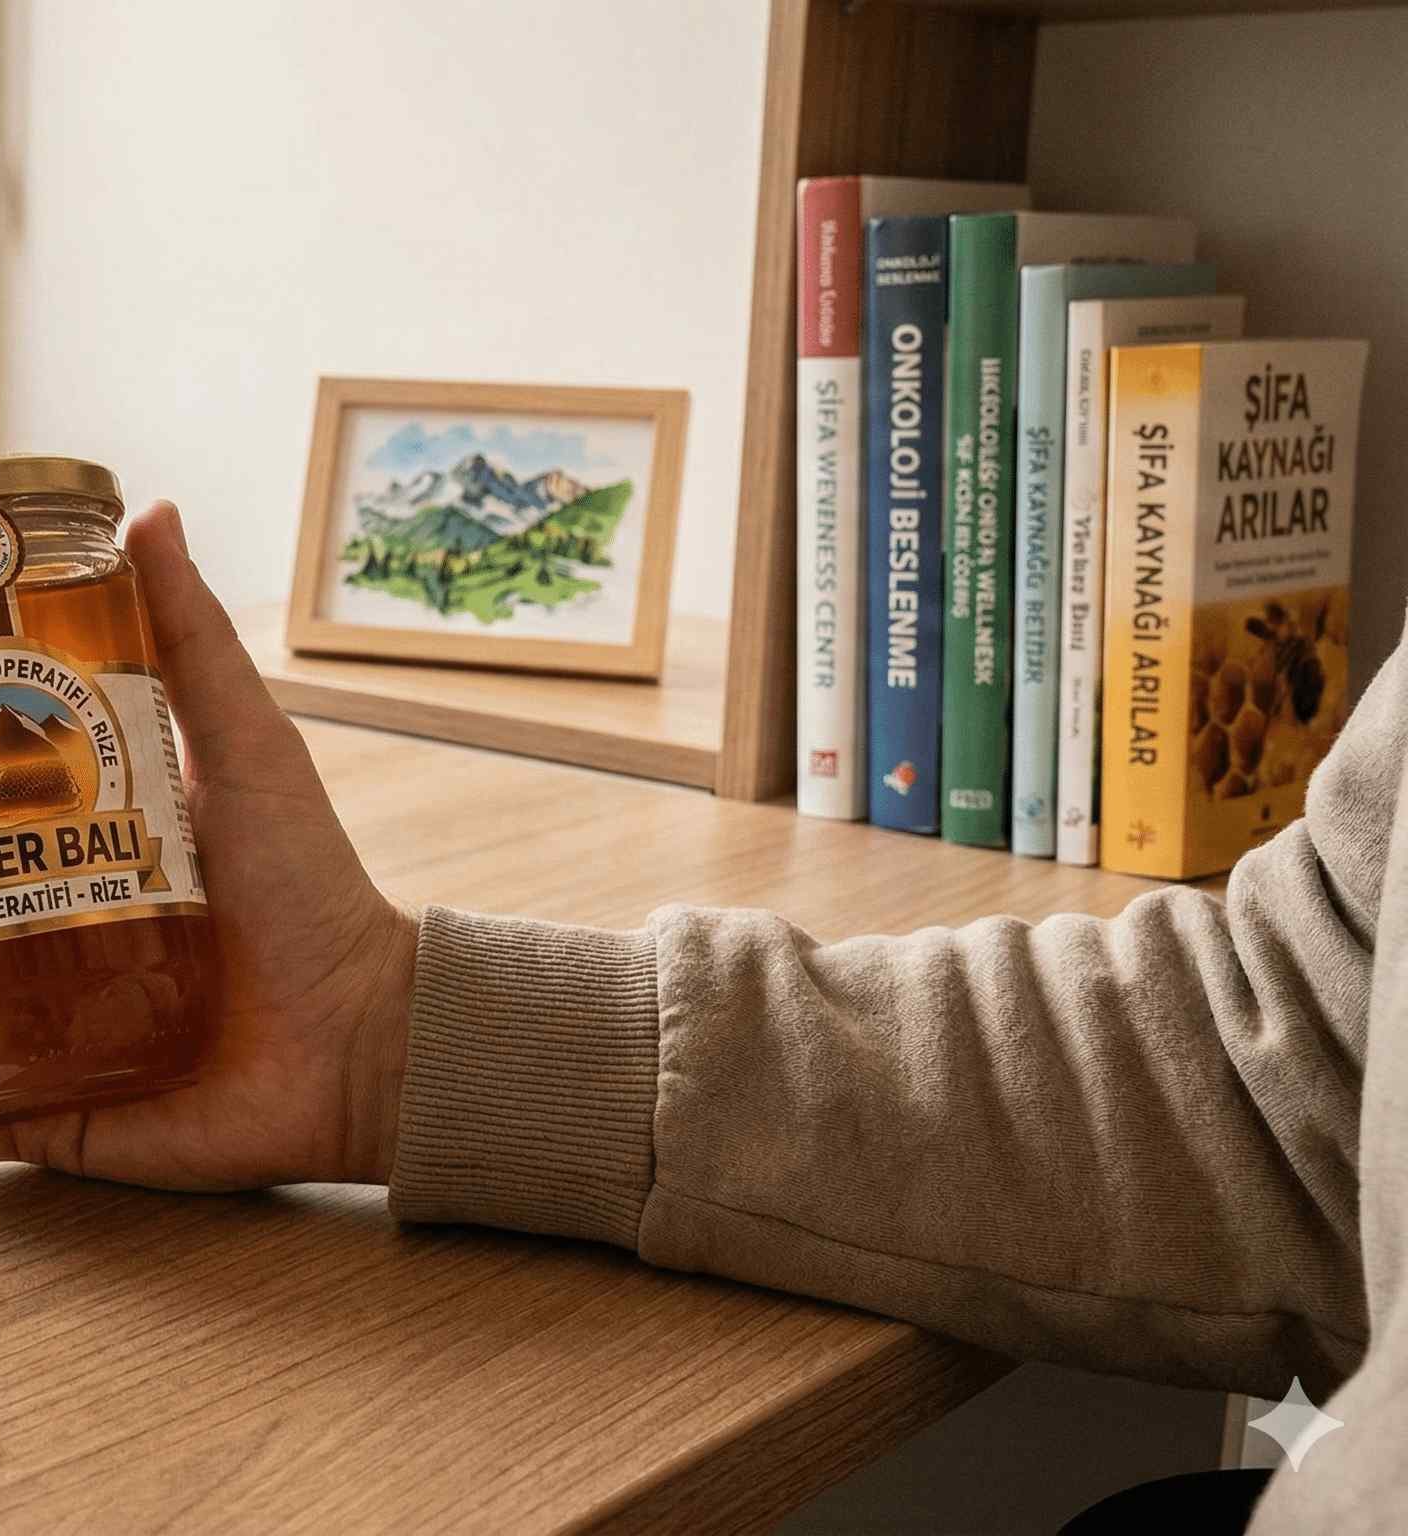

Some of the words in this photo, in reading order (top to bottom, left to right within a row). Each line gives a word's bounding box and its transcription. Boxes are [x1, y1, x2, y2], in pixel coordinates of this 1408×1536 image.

[814, 380, 845, 442] ŞİFA
[889, 324, 927, 500] ONKOLOJİ
[1245, 363, 1310, 433] ŞİFA
[1026, 426, 1054, 474] ŞİFA
[1132, 423, 1175, 490] ŞİFA
[1218, 425, 1334, 482] KAYNAĞI
[1215, 488, 1329, 544] ARILAR
[888, 508, 920, 688] BESLENME
[1132, 503, 1170, 641] KAYNAĞI
[815, 601, 837, 689] CENTR
[1129, 652, 1161, 767] ARILAR
[91, 720, 119, 768] RİZE
[55, 820, 141, 868] BALI
[90, 876, 132, 904] RİZE
